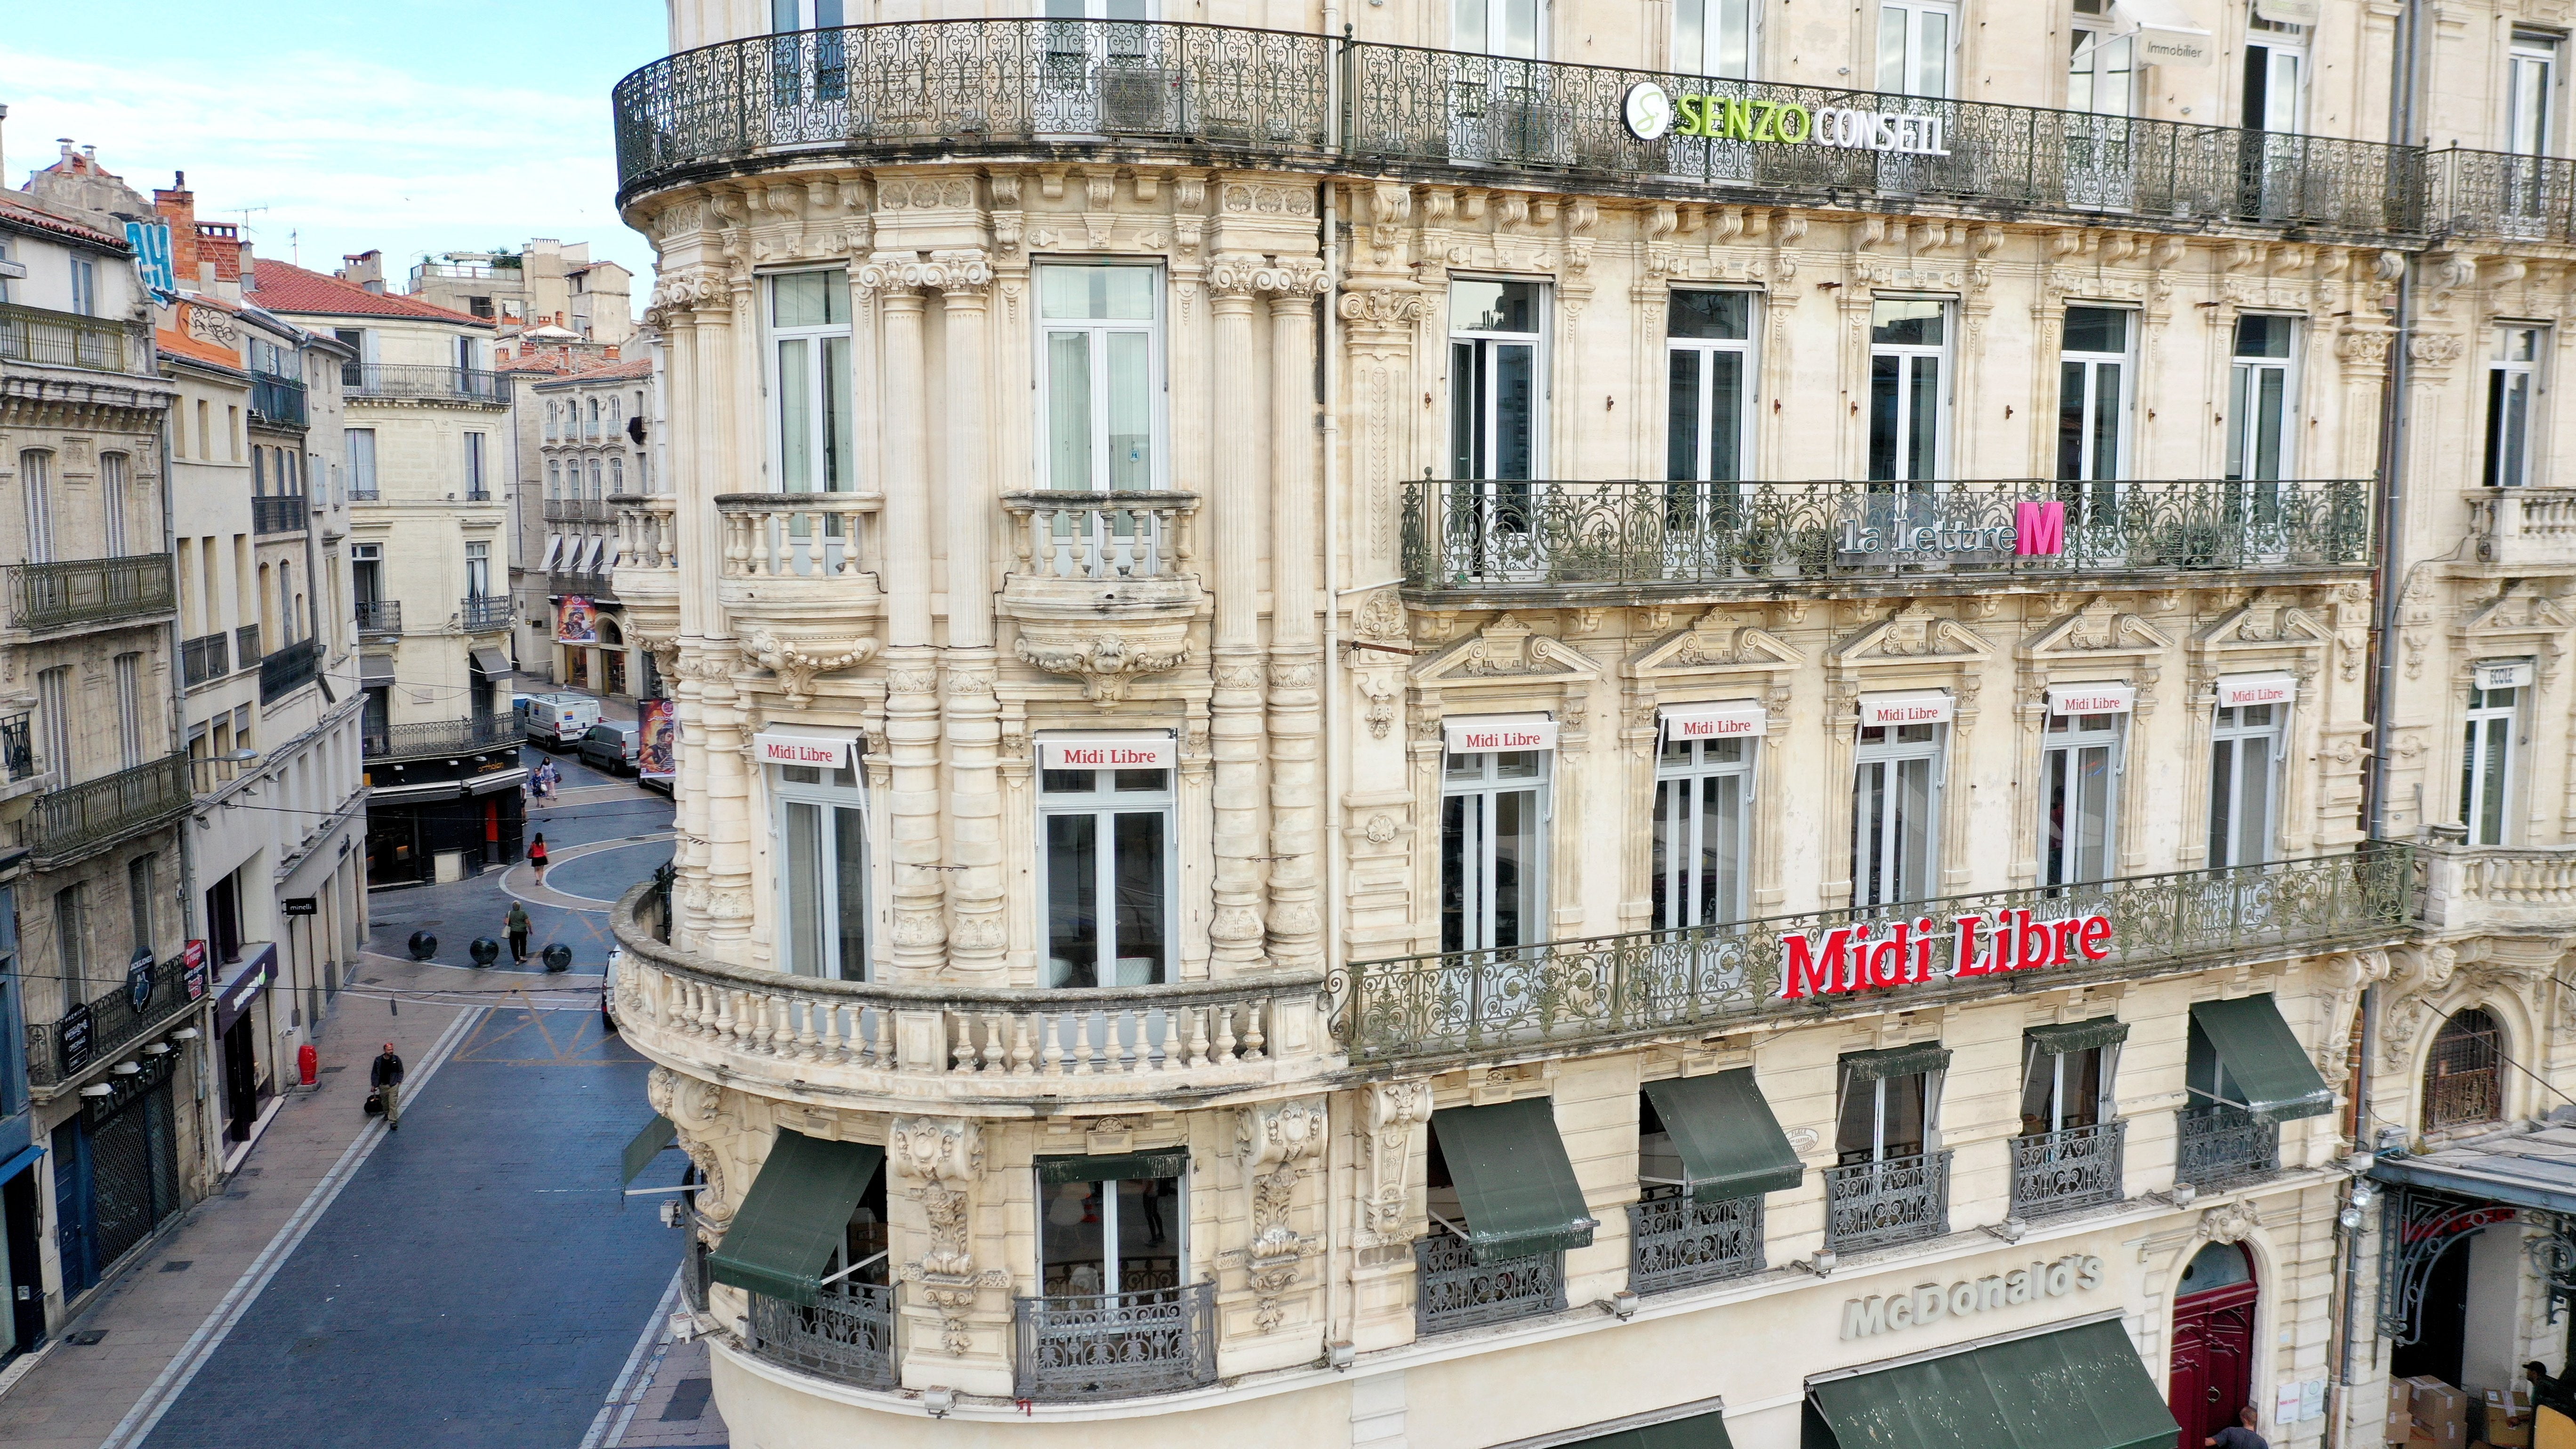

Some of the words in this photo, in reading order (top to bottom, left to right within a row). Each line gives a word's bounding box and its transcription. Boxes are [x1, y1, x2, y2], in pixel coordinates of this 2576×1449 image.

[2147, 41, 2202, 58] Immobilier
[1676, 93, 1810, 145] SENZO
[1812, 106, 1951, 156] CONSEIL
[1838, 518, 1883, 554] la
[1889, 517, 2018, 553] lettre
[2016, 501, 2065, 555] M
[2232, 691, 2254, 702] Midi
[2257, 688, 2283, 700] Libre
[2064, 699, 2089, 710] Midi
[2093, 697, 2120, 709] Libre
[1876, 709, 1904, 722] Midi
[1909, 707, 1938, 720] Libre
[1683, 722, 1713, 735] Midi
[1718, 720, 1751, 733] Libre
[1466, 734, 1499, 748] Midi
[1504, 733, 1540, 747] Libre
[768, 744, 796, 759] Midi
[800, 747, 832, 763] Libre
[1064, 749, 1104, 764] Midi
[1111, 749, 1156, 764] Libre
[1776, 917, 1933, 999] Midi
[1946, 909, 2112, 978] Libre
[1792, 1128, 1806, 1136] PLACE
[1796, 1139, 1815, 1152] COMEDIE
[1840, 1253, 2104, 1340] McDonald's
